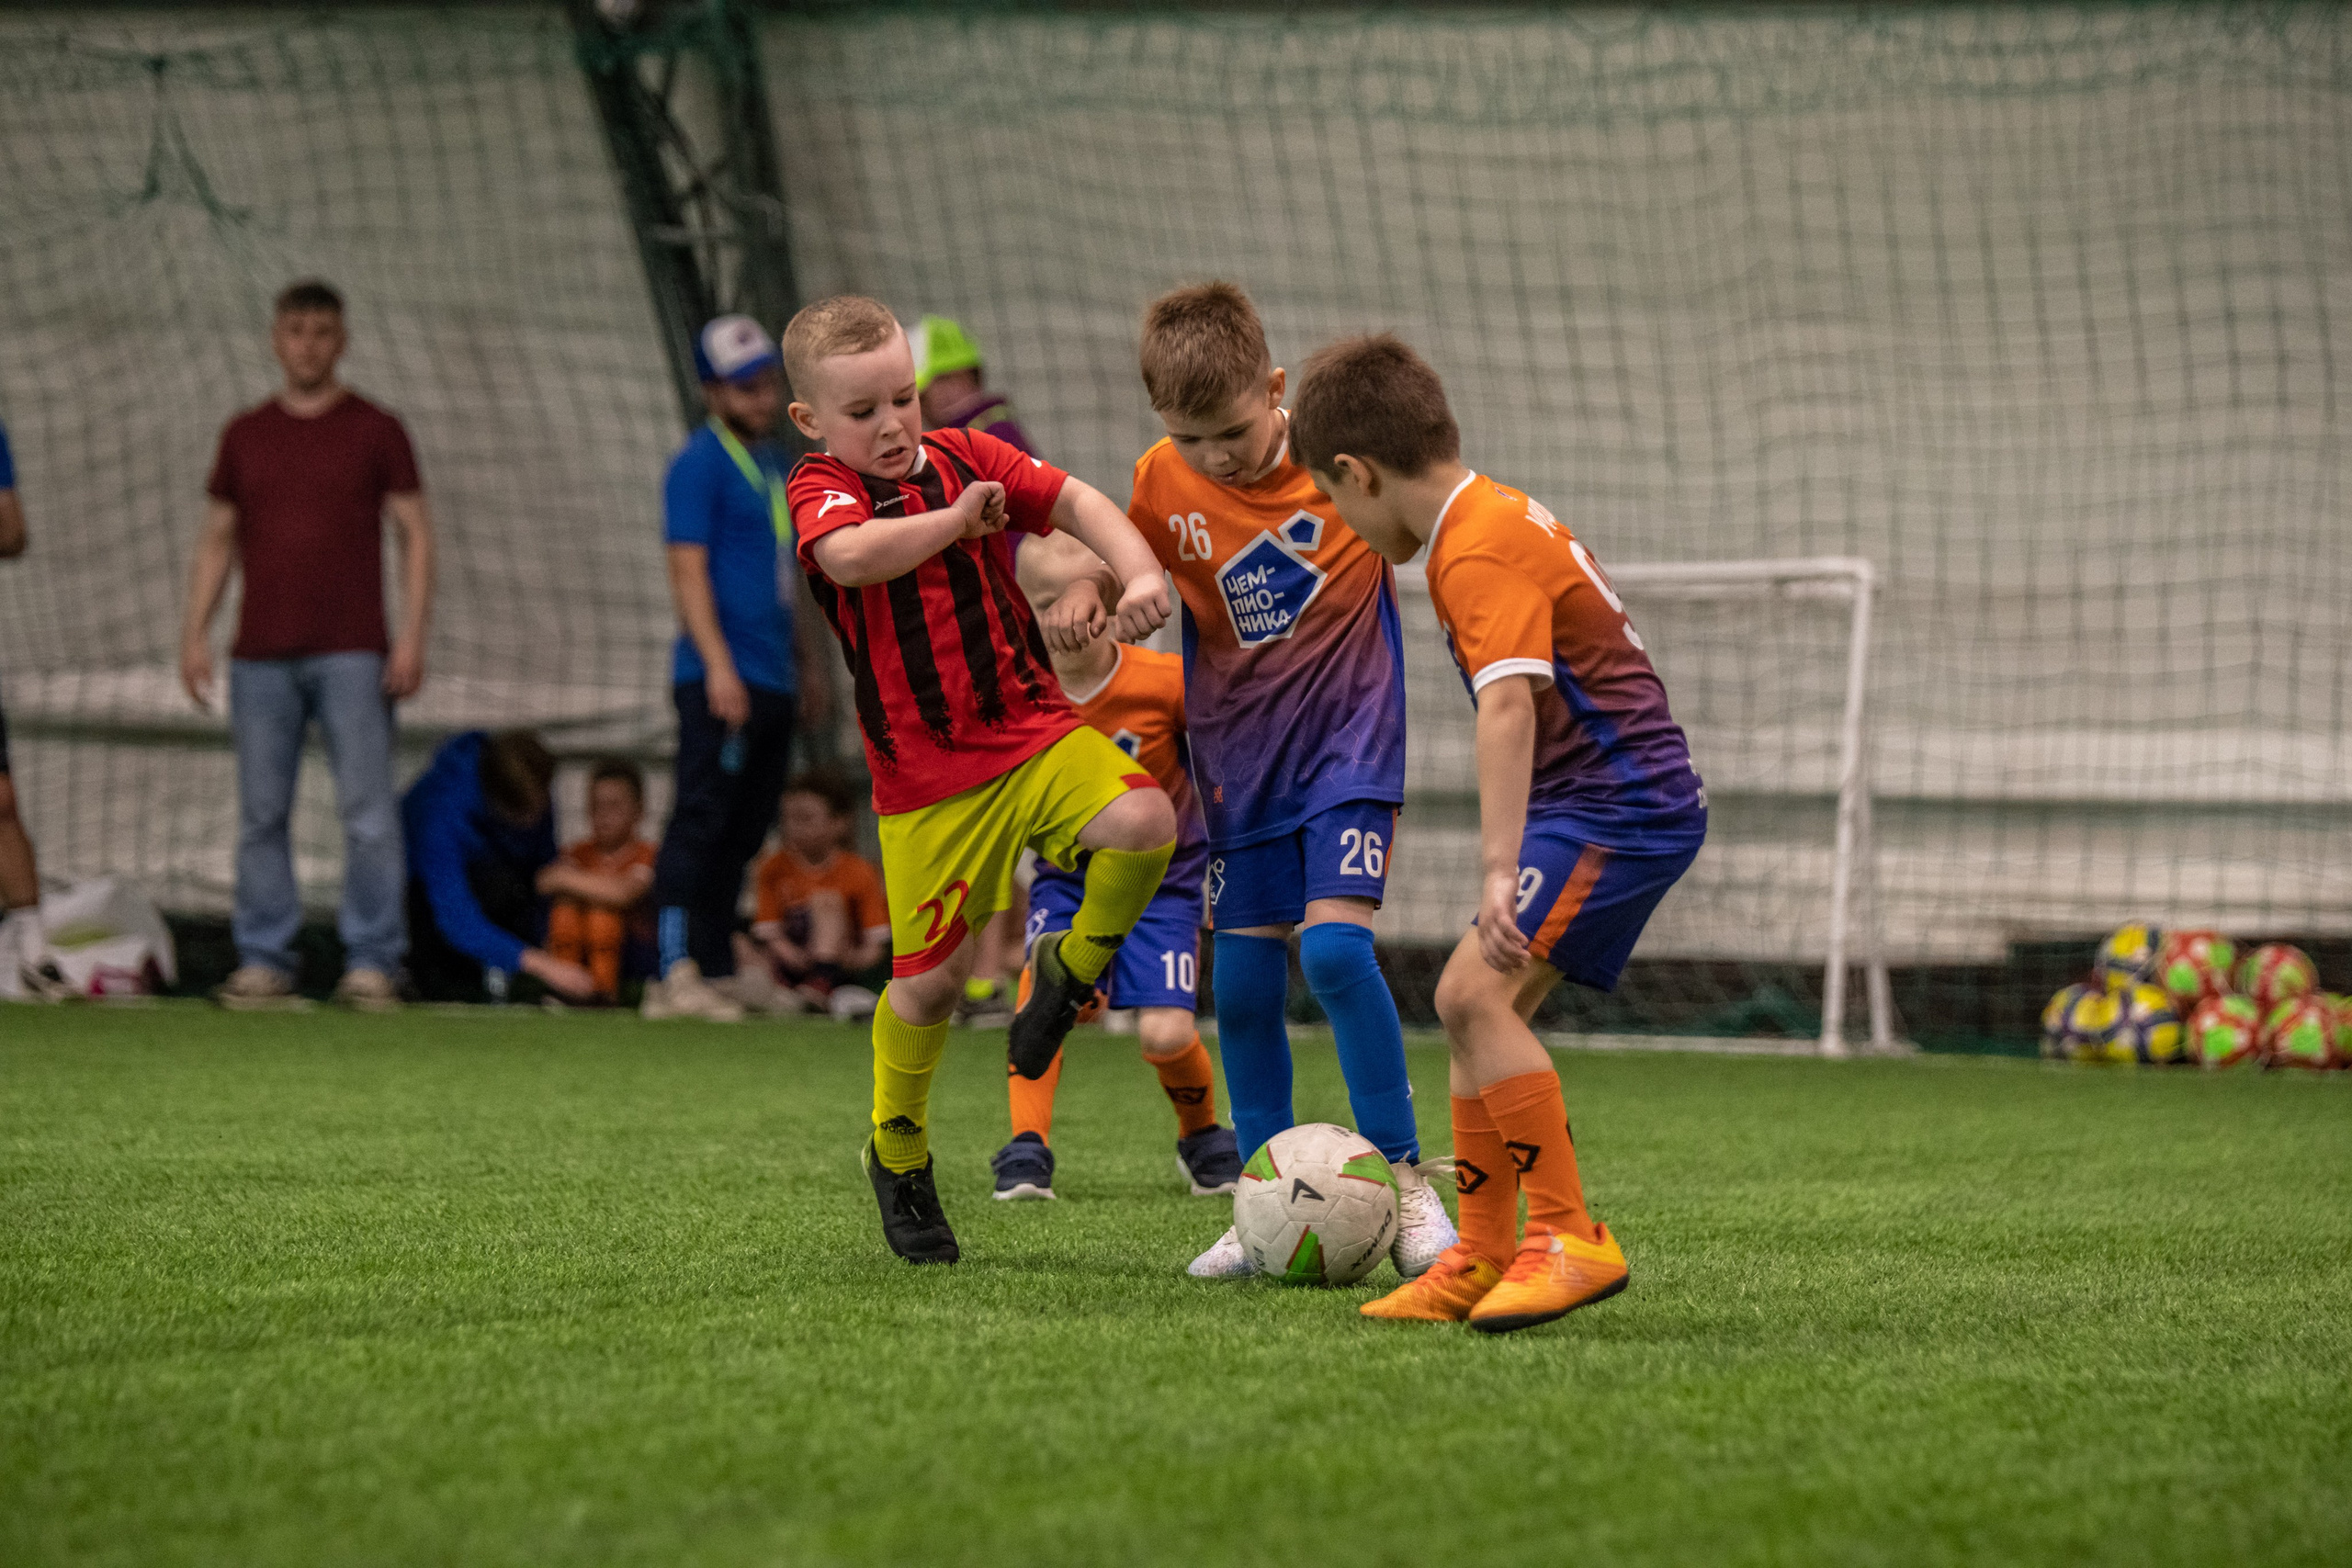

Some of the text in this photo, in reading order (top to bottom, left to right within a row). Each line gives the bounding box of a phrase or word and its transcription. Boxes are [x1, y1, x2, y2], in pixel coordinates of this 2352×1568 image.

[1168, 512, 1212, 561] 26
[1226, 564, 1276, 596] ЧЕМ-
[1232, 589, 1284, 615] ПИО-
[1238, 609, 1291, 633] НИКА
[1340, 828, 1384, 878] 26
[917, 879, 969, 943] 22
[1516, 864, 1544, 913] 9
[1160, 950, 1194, 993] 10
